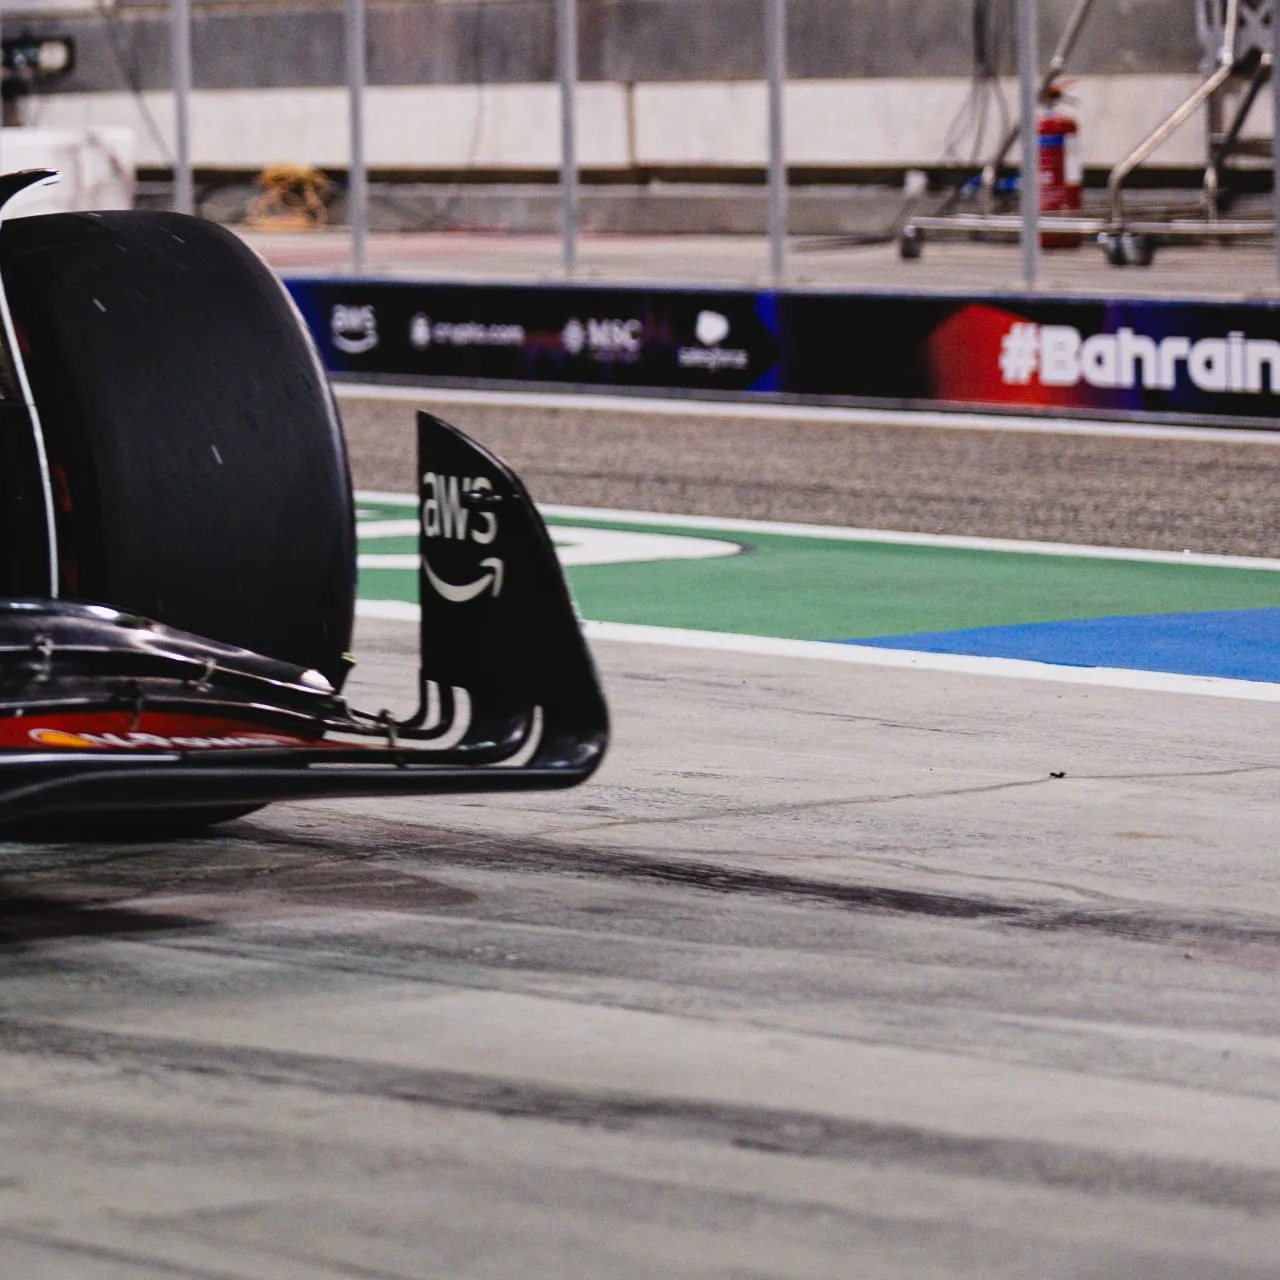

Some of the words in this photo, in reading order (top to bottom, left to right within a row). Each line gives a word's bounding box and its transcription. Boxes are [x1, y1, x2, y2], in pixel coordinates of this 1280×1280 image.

[586, 319, 642, 349] MSC
[1000, 323, 1280, 393] #Bahrain
[423, 472, 497, 544] aws
